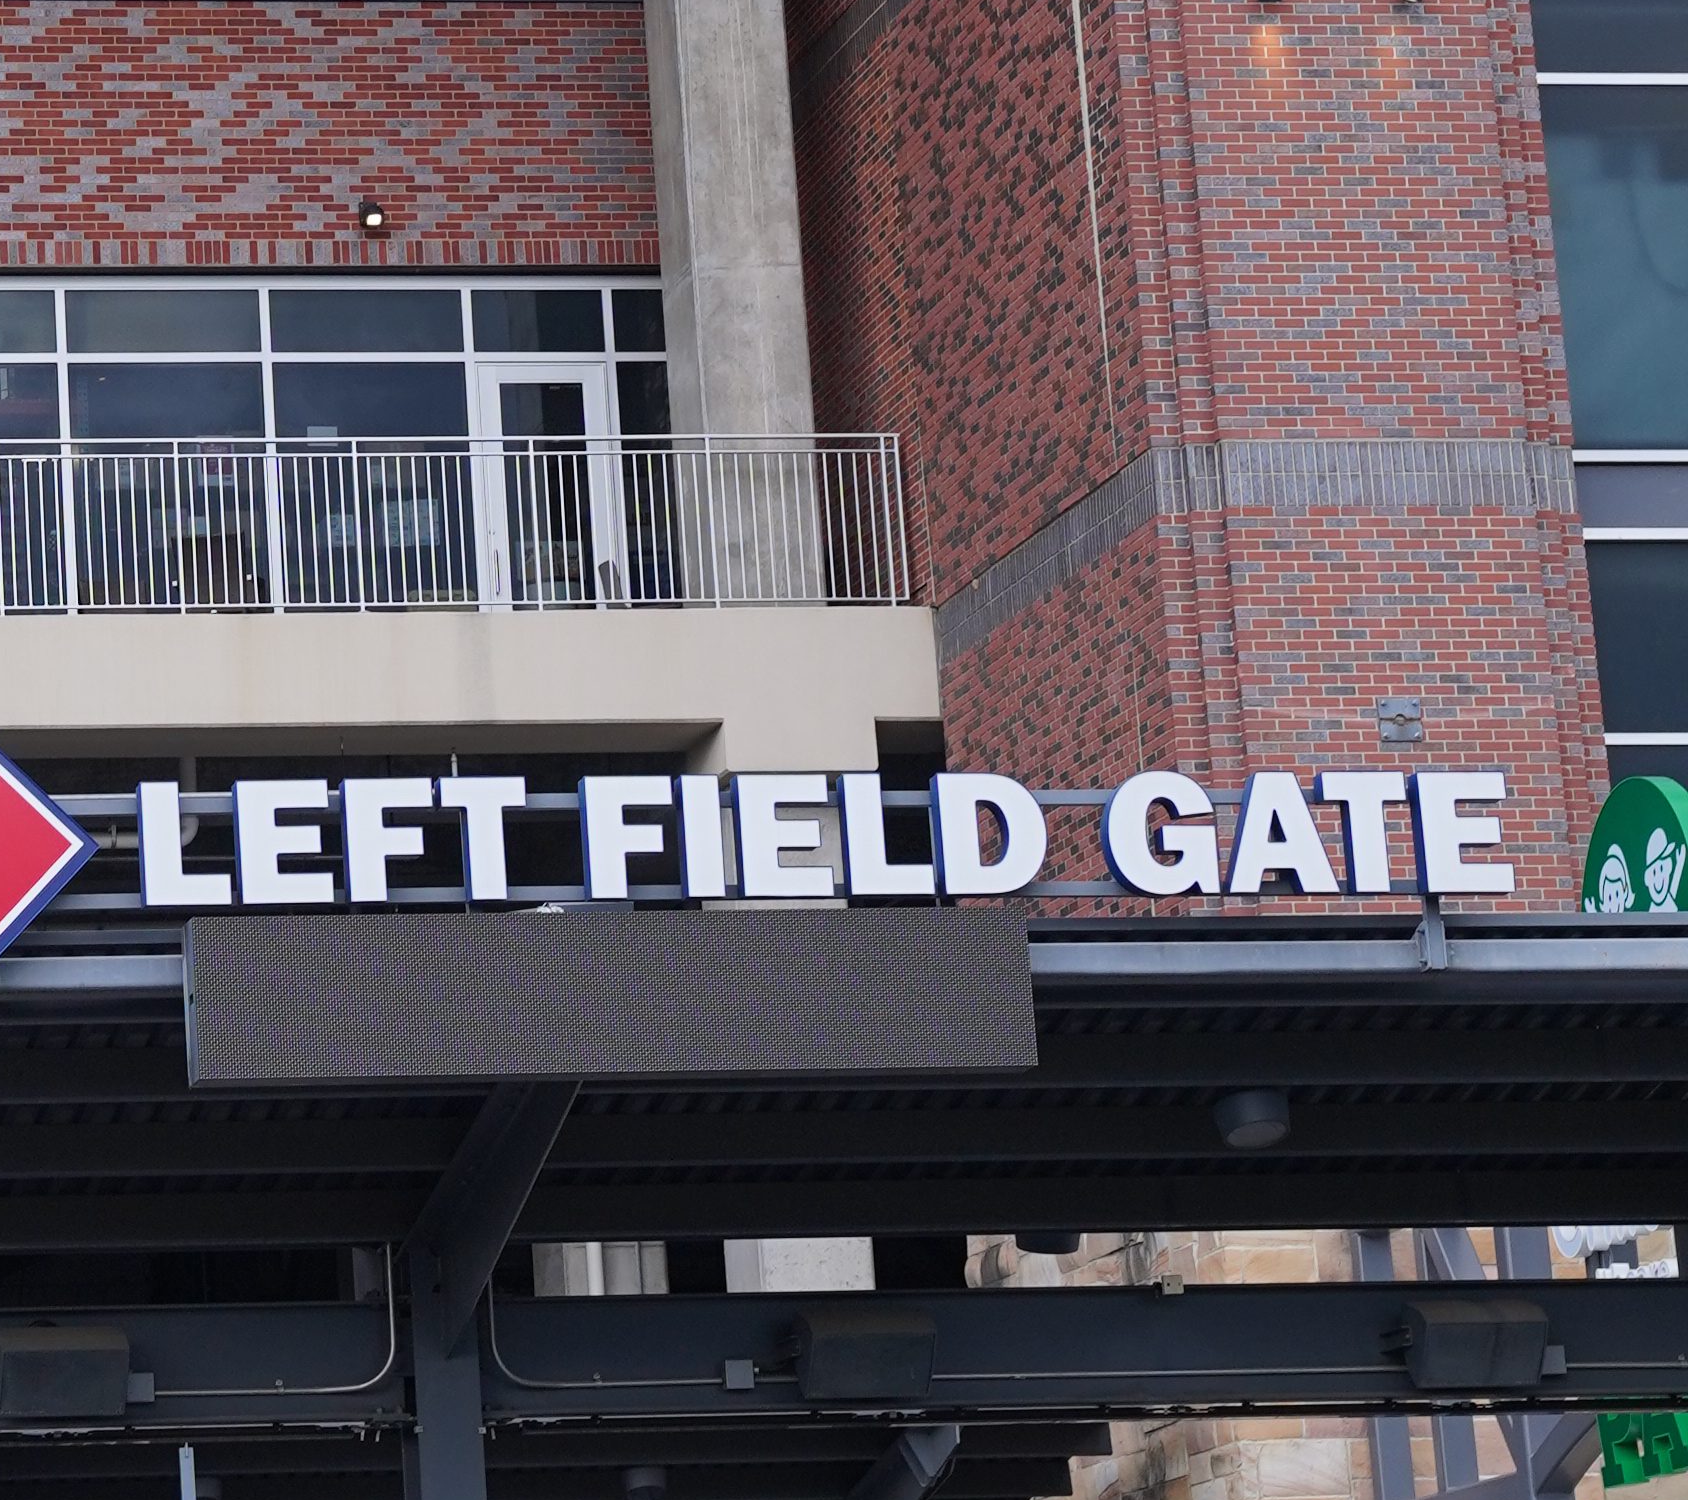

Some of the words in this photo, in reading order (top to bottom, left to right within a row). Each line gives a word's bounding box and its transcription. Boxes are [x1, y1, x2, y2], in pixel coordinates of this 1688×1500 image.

[136, 775, 527, 906] LEFT
[577, 773, 1049, 899] FIELD
[1101, 770, 1516, 896] GATE
